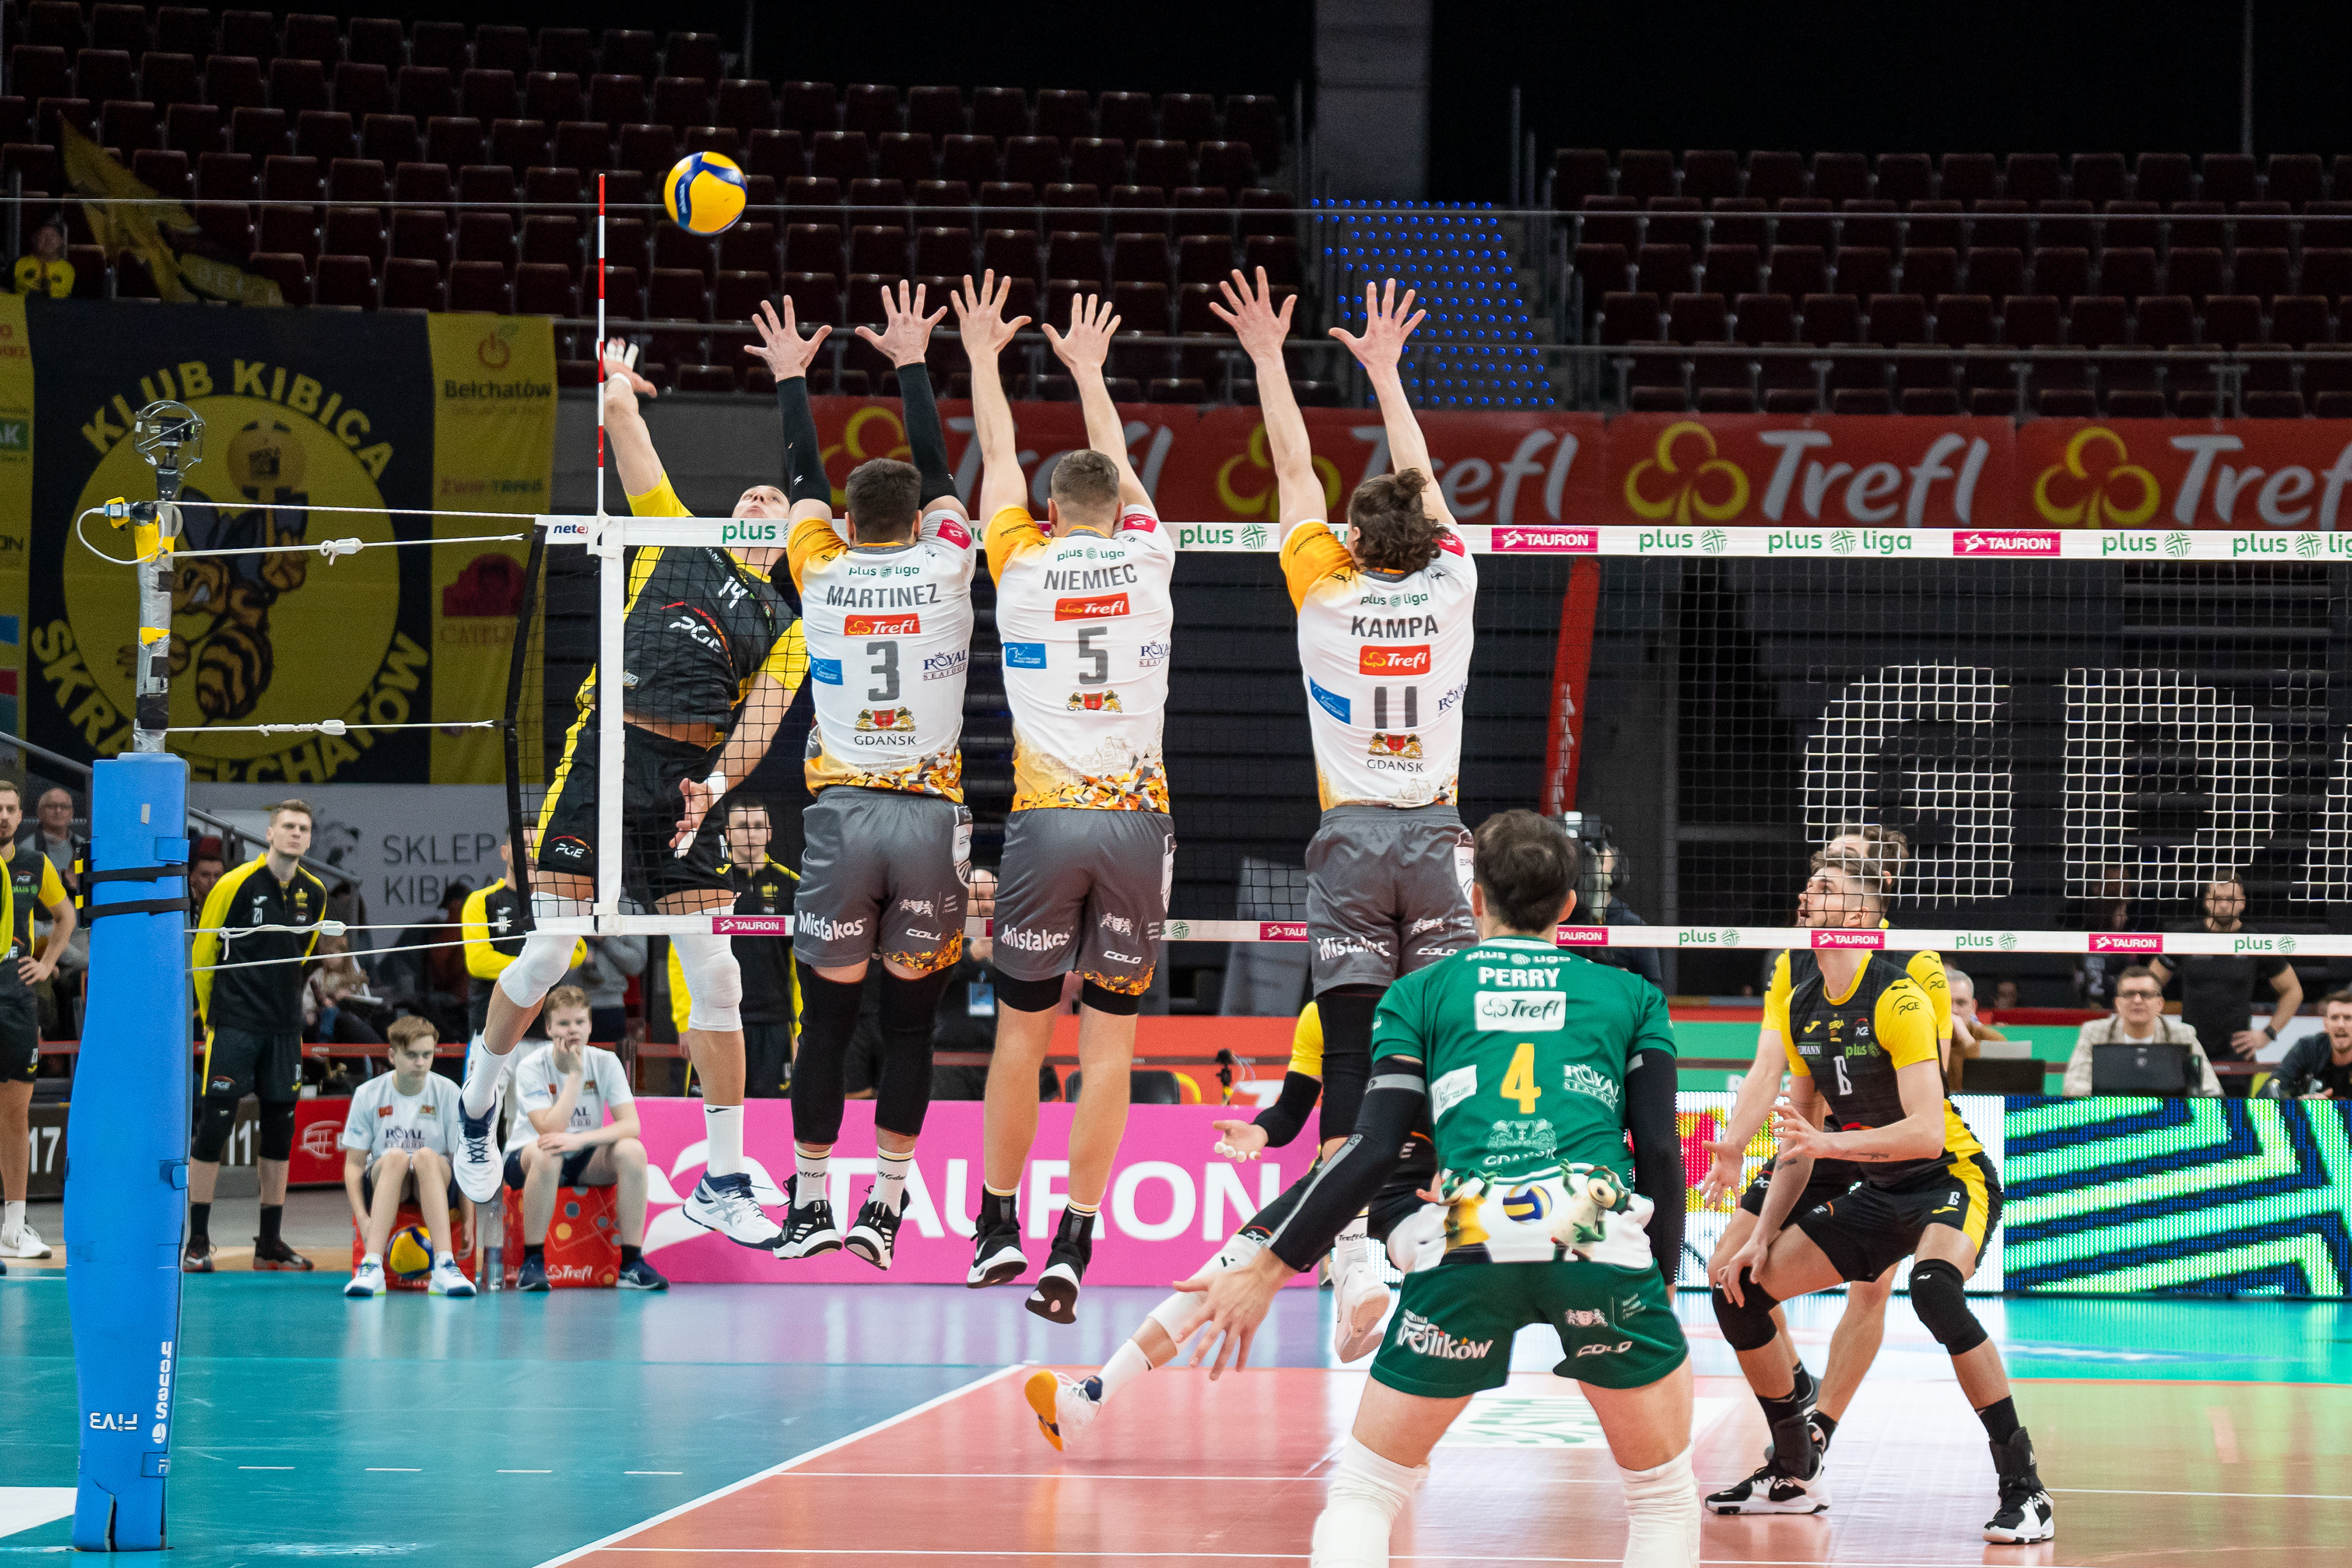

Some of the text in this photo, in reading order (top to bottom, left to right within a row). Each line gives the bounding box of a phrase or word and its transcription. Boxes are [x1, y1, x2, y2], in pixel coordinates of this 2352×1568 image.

[82, 359, 394, 481] KLUB KIBICA
[1352, 424, 1579, 526] Tefl
[1758, 430, 1989, 527] Trefl
[722, 520, 776, 544] plus
[1180, 525, 1234, 548] plus
[1526, 533, 1589, 546] TAURON
[1639, 531, 1693, 552] plus
[1768, 530, 1912, 552] plus liga
[1989, 537, 2051, 550] TAURON
[2102, 532, 2157, 556] plus
[2233, 532, 2288, 557] plus
[1057, 549, 1082, 561] plus
[849, 565, 876, 576] plus
[1044, 563, 1138, 590] NIEMIEC
[826, 582, 942, 608] MARTINEZ
[1360, 592, 1428, 606] plus liga
[1085, 600, 1125, 614] Trefl
[872, 619, 915, 635] Trefl
[1351, 614, 1439, 638] KAMPA
[923, 649, 967, 671] ROYAL
[1078, 625, 1109, 685] 5
[1387, 651, 1427, 668] Trefl
[866, 640, 899, 701] 3
[187, 631, 429, 783] EŁCHATÓW
[1374, 685, 1418, 729] 11
[854, 733, 917, 746] GDAŃSK
[1366, 759, 1424, 772] GDAŃSK
[383, 833, 497, 865] SKLEP
[735, 921, 780, 931] TAURON
[799, 910, 865, 941] Mistakos
[1558, 930, 1603, 941] TAURON
[1001, 924, 1071, 951] Mistakos
[1679, 929, 1716, 945] plus
[1834, 934, 1879, 945] TAURON
[1956, 933, 1993, 949] plus
[2111, 938, 2157, 949] TAURON
[2234, 936, 2273, 953] plus
[1103, 949, 1142, 965] COLO
[1478, 966, 1561, 988] PERRY
[1511, 998, 1560, 1020] Trefl
[1899, 1001, 1920, 1015] PGE
[1845, 1042, 1867, 1059] plus
[1500, 1042, 1542, 1114] 4
[1833, 1055, 1853, 1096] 6
[1948, 1191, 1960, 1205] 6
[1396, 1317, 1493, 1360] Treflików
